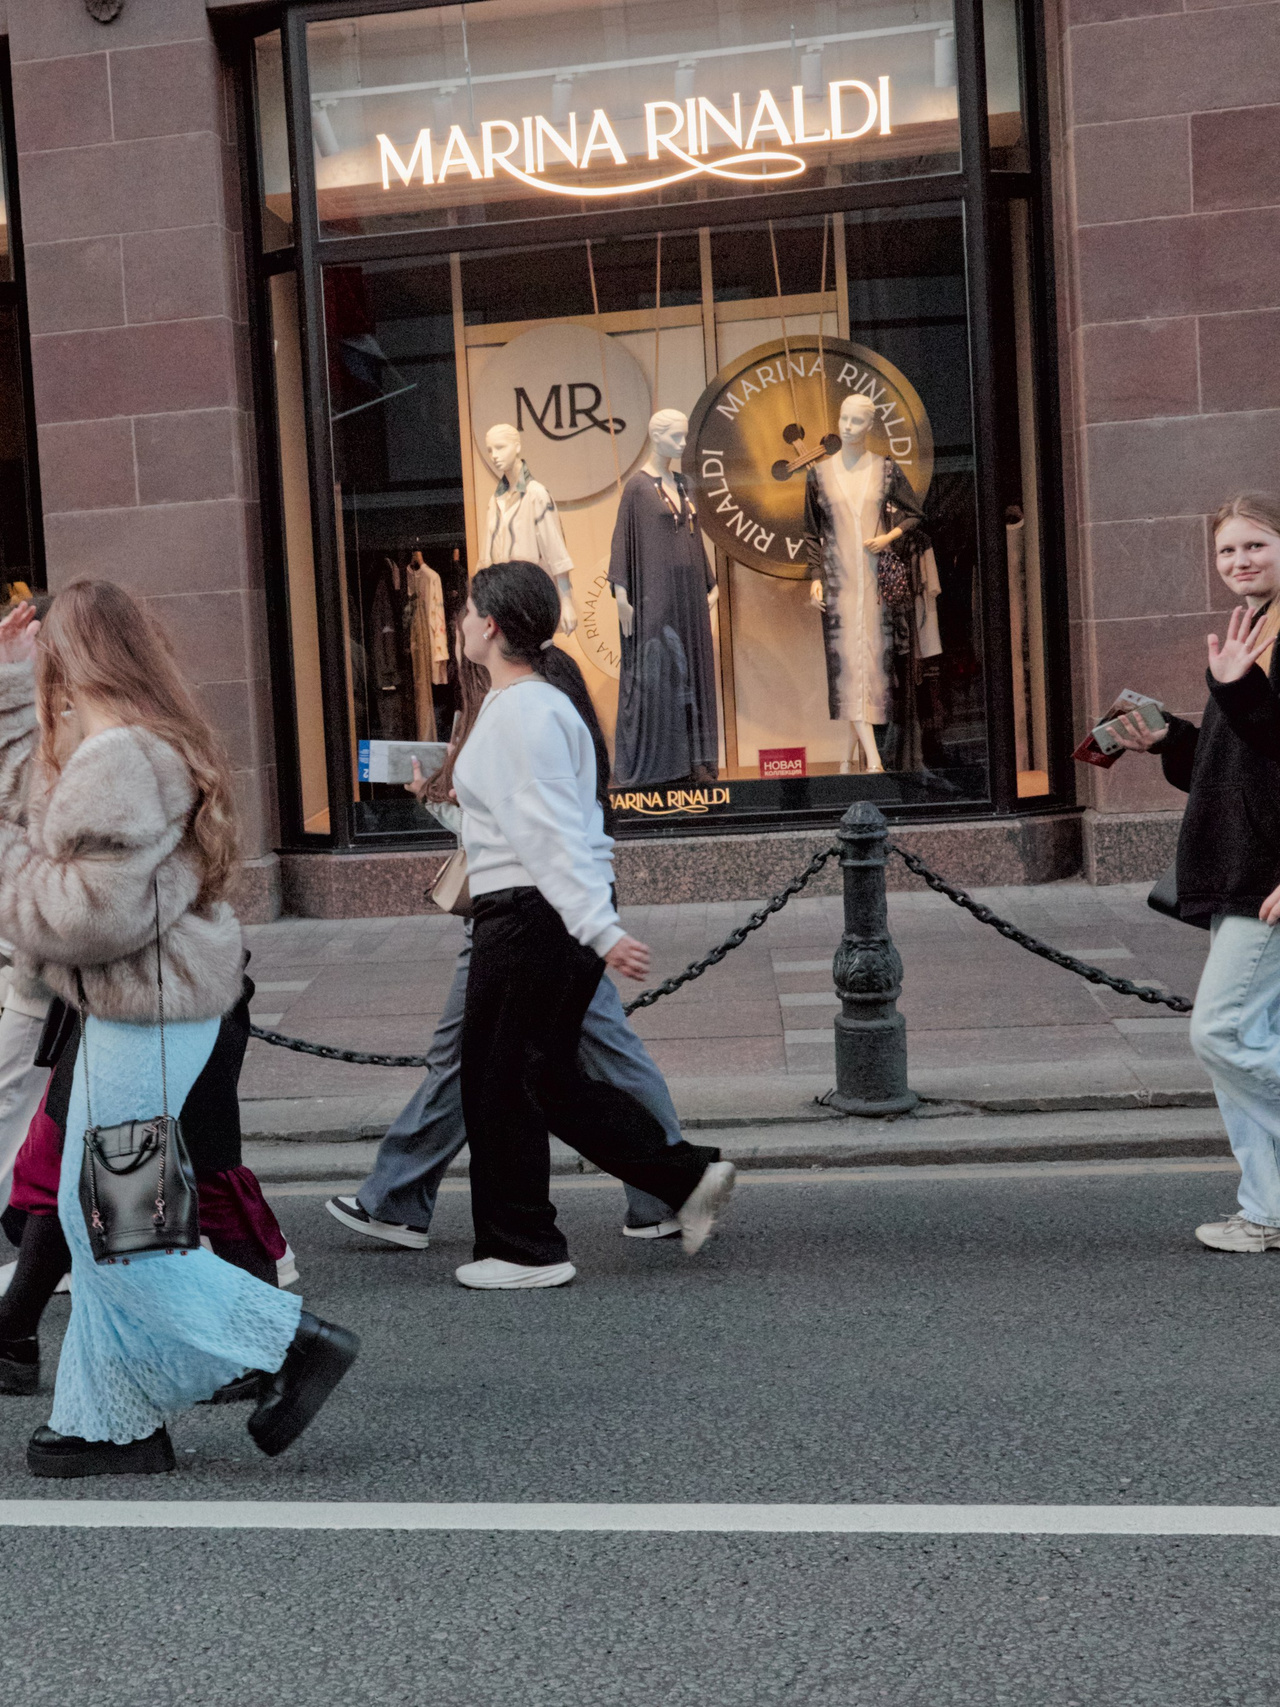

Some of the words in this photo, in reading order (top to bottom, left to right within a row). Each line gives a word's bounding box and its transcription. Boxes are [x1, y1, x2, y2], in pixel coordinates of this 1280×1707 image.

[376, 108, 628, 197] MARINA
[644, 75, 892, 180] RINALDI
[716, 355, 826, 422] MARINA
[836, 362, 913, 466] RINALDI
[701, 449, 776, 554] RINALDI
[666, 787, 731, 814] RINALDI
[763, 759, 803, 771] НОВАЯ
